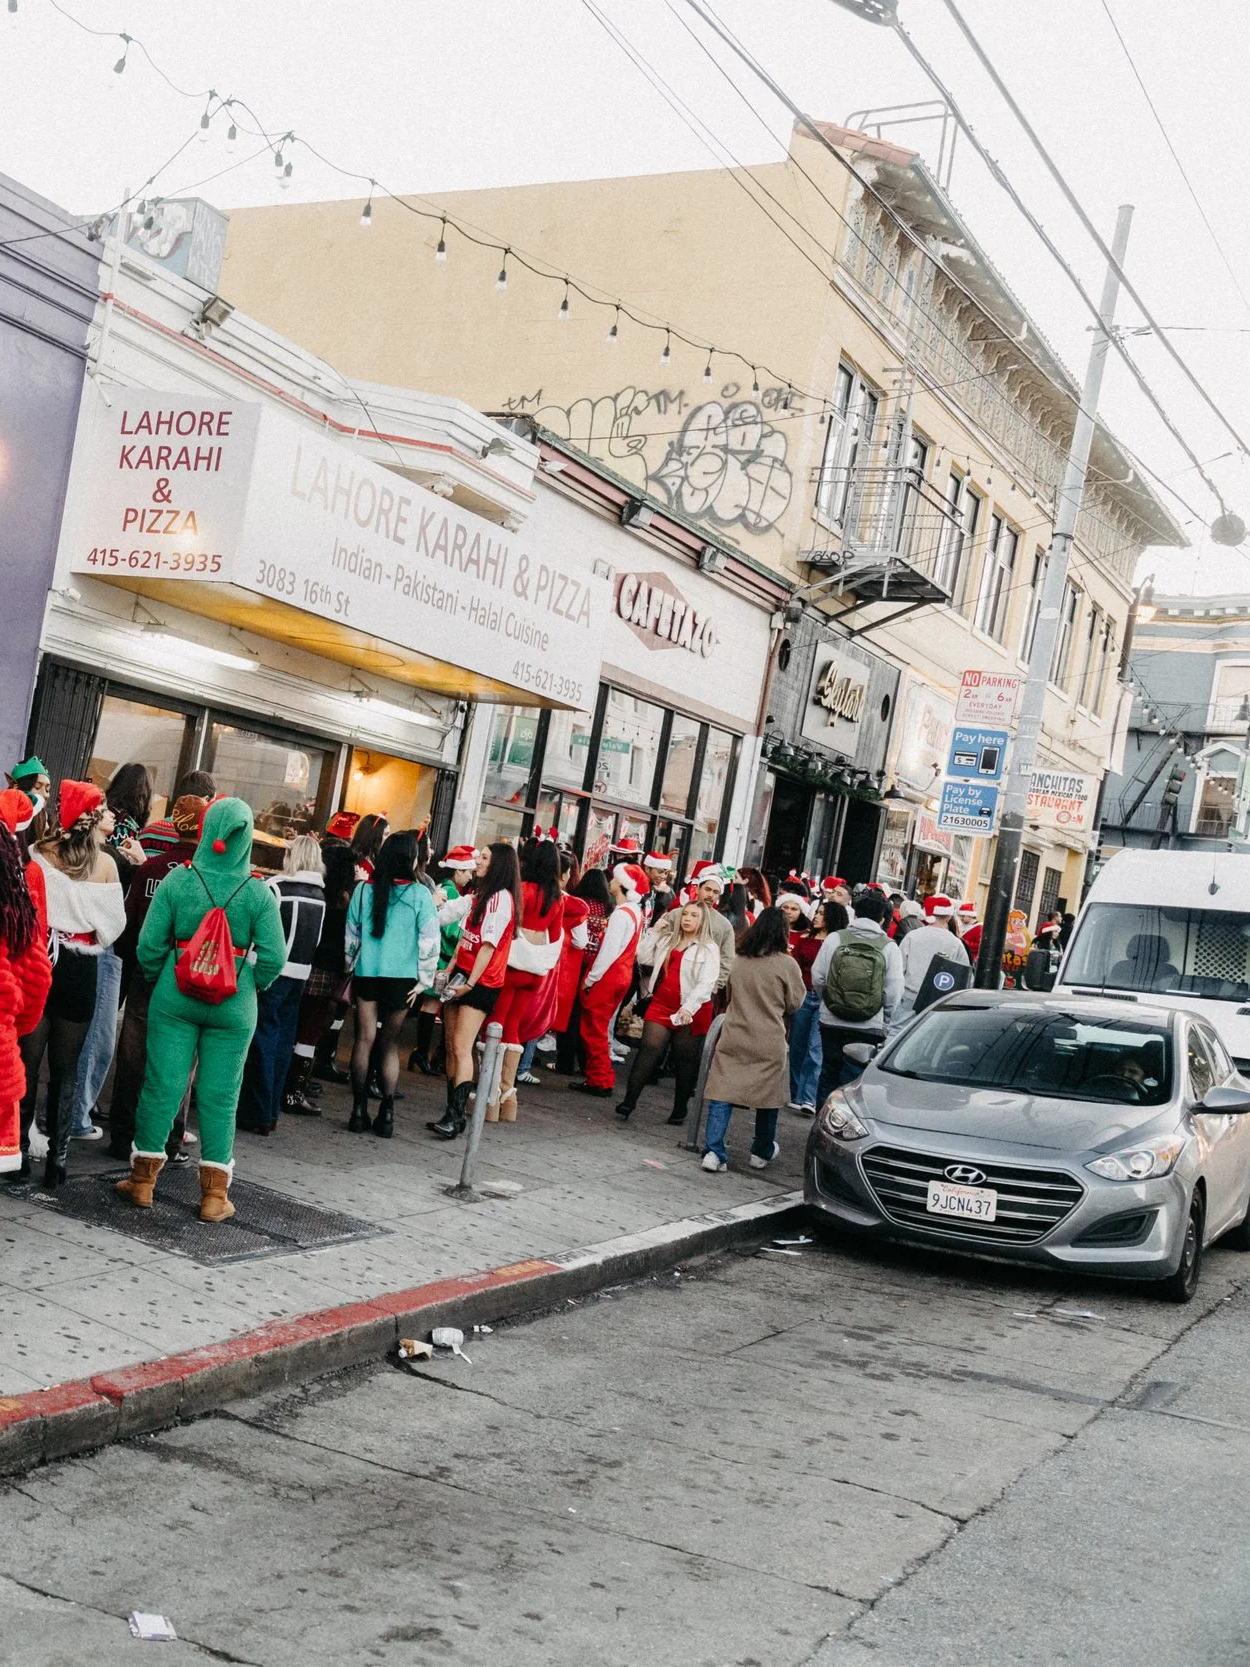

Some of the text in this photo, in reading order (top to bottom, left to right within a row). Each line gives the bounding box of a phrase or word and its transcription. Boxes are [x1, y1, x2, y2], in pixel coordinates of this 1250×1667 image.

[120, 410, 232, 437] LAHORE
[119, 445, 223, 472] KARAHI
[151, 479, 173, 504] &
[121, 509, 200, 536] PIZZA
[291, 444, 591, 628] LAHORE KARAHI & PIZZA
[87, 547, 223, 574] 415-621-3935
[256, 559, 350, 617] 3083 16th St
[332, 537, 383, 584] Indian
[393, 564, 459, 615] Pakistani
[468, 595, 504, 633] Halal
[505, 612, 549, 651] Cuisine
[618, 573, 716, 659] CAFETAZO
[512, 660, 583, 702] 415-621-3935
[963, 672, 1017, 689] NO PARKING
[969, 702, 1003, 710] EVERYDAY
[955, 732, 1005, 746] Pay here
[946, 784, 982, 798] Pay by
[1030, 772, 1084, 793] ANCHITAS
[943, 804, 970, 814] Plate
[944, 794, 983, 806] License
[1026, 794, 1084, 812] STAURANT
[942, 815, 988, 828] 21630005
[932, 1193, 991, 1216] 9JCN437
